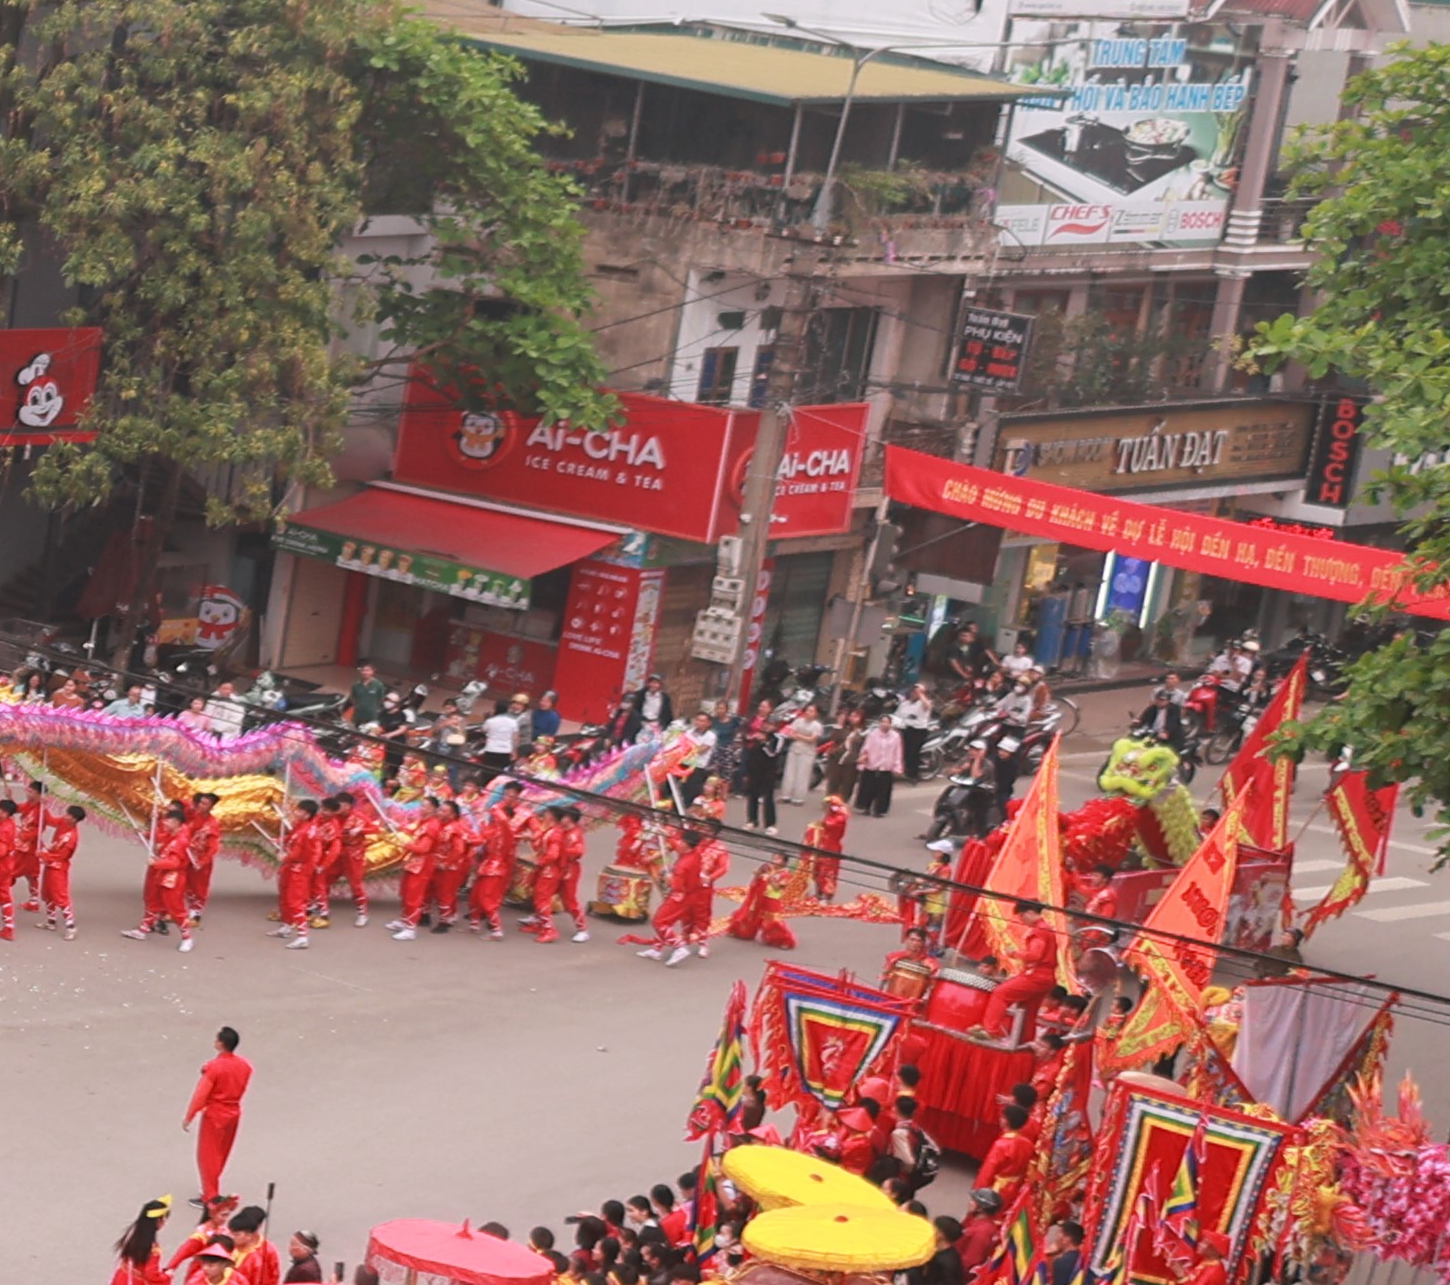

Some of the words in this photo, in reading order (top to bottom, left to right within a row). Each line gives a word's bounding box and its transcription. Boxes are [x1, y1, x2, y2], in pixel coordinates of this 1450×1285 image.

[1092, 37, 1146, 68] TRUNG
[1147, 31, 1187, 68] TÂM
[1102, 76, 1127, 111] VÀ
[1127, 73, 1164, 112] BẢO
[1210, 74, 1247, 112] BẾP
[1179, 210, 1224, 230] BOSCH
[525, 418, 666, 470] Ai-CHA
[1115, 417, 1181, 475] TUẤN
[1179, 429, 1229, 475] ĐẠT
[1319, 398, 1358, 505] BOSCH
[525, 454, 550, 470] ICE
[555, 459, 610, 482] CREAM
[614, 472, 629, 485] &
[633, 474, 663, 491] TEA
[776, 448, 851, 479] Ai-CHA
[788, 482, 819, 496] CREAM
[828, 479, 847, 492] TEA
[941, 477, 980, 506] CHÀO
[980, 486, 1023, 517] MỪNG
[1048, 502, 1096, 533] KHÁCH
[1100, 509, 1121, 537] VỀ
[1147, 518, 1169, 548] LỄ
[1169, 526, 1196, 556] HỘI
